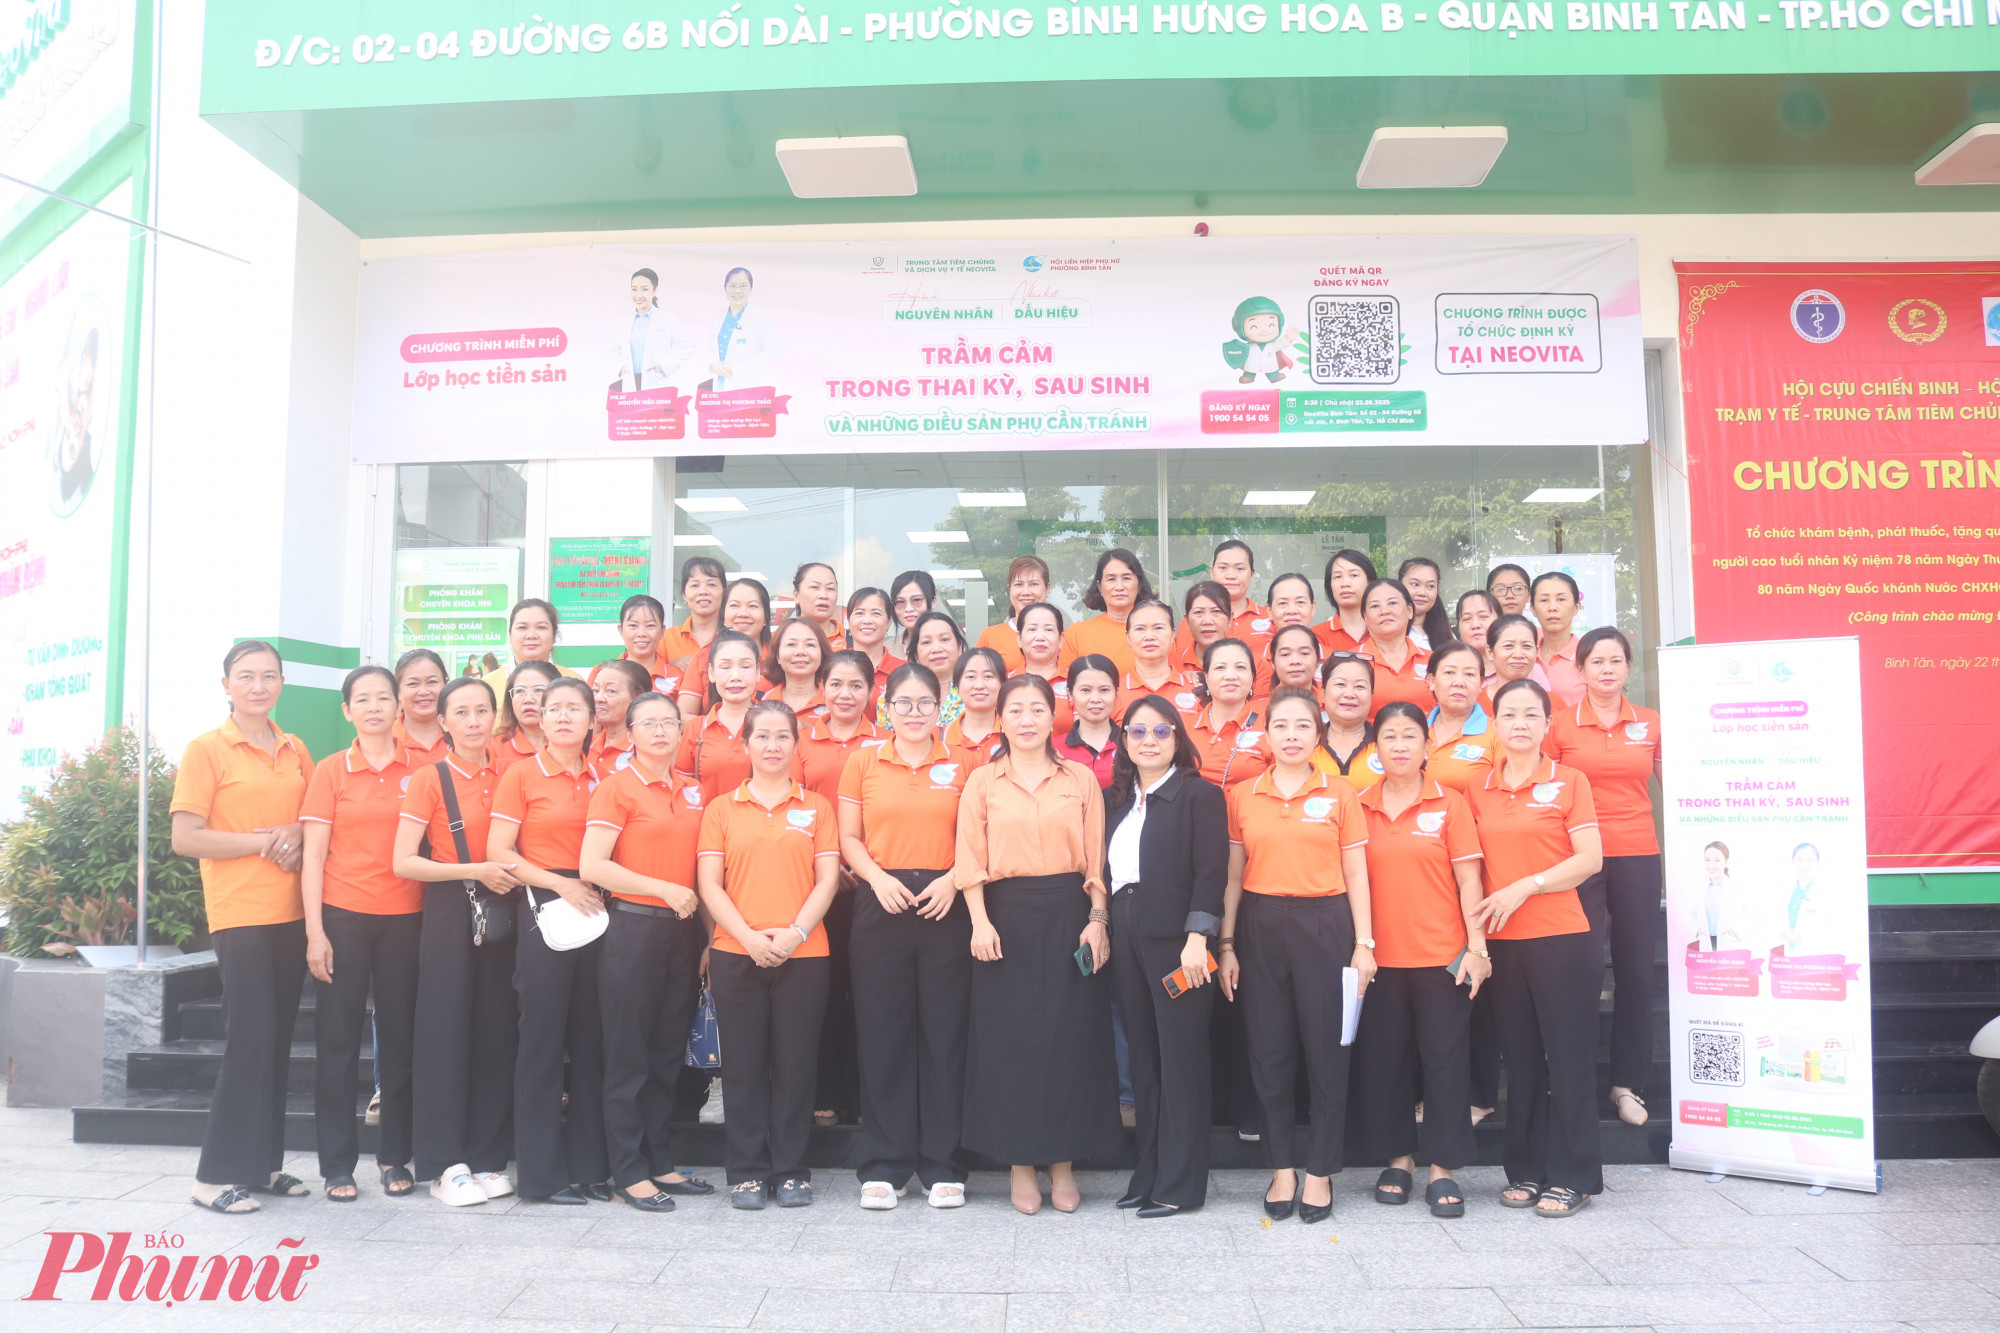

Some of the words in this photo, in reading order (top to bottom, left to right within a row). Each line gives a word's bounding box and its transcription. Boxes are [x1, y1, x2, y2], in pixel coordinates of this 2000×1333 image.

[255, 35, 341, 67] Đ/C:
[470, 13, 612, 57] ĐƯỜNG
[622, 20, 668, 50] 6B
[681, 2, 749, 49] NỐI
[763, 3, 828, 46] DÀI
[864, 0, 1033, 41] PHƯỜNG
[1153, 4, 1267, 34] HƯNG
[1381, 3, 1403, 32] B
[1320, 266, 1346, 275] QUÉT
[1350, 266, 1364, 274] MÃ
[1314, 278, 1342, 286] ĐĂNG
[1346, 278, 1358, 286] KÝ
[896, 308, 949, 319] NGUYÊN
[954, 307, 992, 318] NHÂN
[1015, 303, 1042, 318] DẤU
[1046, 306, 1077, 319] HIỆU
[1443, 307, 1503, 321] CHƯƠNG
[1508, 305, 1542, 318] TRÌNH
[1547, 308, 1586, 320] ĐƯỢC
[1458, 322, 1474, 337] TỔ
[1478, 324, 1515, 337] CHỨC
[1520, 326, 1553, 339] ĐỊNH
[1558, 324, 1574, 336] KỲ
[410, 341, 461, 354] CHƯƠNG
[464, 338, 501, 351] TRÌNH
[504, 334, 535, 350] MIỄN
[538, 335, 560, 347] PHÍ
[921, 337, 990, 364] TRẦM
[999, 339, 1051, 363] CẢM
[1448, 346, 1482, 368] TẠI
[1490, 345, 1584, 362] NEOVITA
[404, 370, 439, 391] Lớp
[446, 368, 480, 389] học
[486, 363, 525, 383] tiền
[531, 363, 566, 382] sản
[826, 379, 910, 397] TRONG
[918, 379, 974, 395] THAI
[984, 373, 1021, 398] KỲ,
[1035, 377, 1083, 394] SAU
[1091, 376, 1148, 393] SINH
[1783, 379, 1814, 399] HỘI
[1819, 381, 1856, 399] CỰU
[1861, 376, 1914, 395] CHIẾN
[1918, 381, 1960, 396] BINH
[1209, 403, 1234, 412] ĐĂNG
[1236, 402, 1245, 412] KÝ
[1248, 404, 1270, 412] NGAY
[1715, 408, 1762, 425] TRẠM
[1767, 408, 1778, 421] Y
[1782, 402, 1800, 421] TẾ
[1814, 406, 1871, 421] TRUNG
[1875, 404, 1912, 420] TÂM
[1916, 403, 1955, 420] TIÊM
[829, 416, 853, 432] VÀ
[857, 416, 918, 431] NHỮNG
[923, 411, 962, 430] ĐIỀU
[967, 412, 1001, 430] SẢN
[1007, 417, 1041, 432] PHỤ
[1047, 410, 1082, 428] CẦN
[1087, 413, 1146, 430] TRÁNH
[1734, 456, 1910, 490] CHƯƠNG
[1920, 451, 2000, 489] TRÌN
[1746, 525, 1760, 537] Tổ
[1764, 527, 1795, 537] chức
[1799, 526, 1834, 537] khám
[1838, 526, 1873, 539] bệnh,
[1877, 526, 1906, 538] phát
[1910, 524, 1949, 537] thuốc,
[1952, 525, 1982, 538] tặng
[1713, 556, 1748, 569] người
[1752, 558, 1776, 566] cao
[1780, 552, 1804, 565] tuổi
[1808, 555, 1838, 565] nhân
[1843, 554, 1858, 567] Kỷ
[1862, 554, 1892, 567] niệm
[1896, 554, 1911, 564] 78
[1915, 554, 1943, 564] năm
[1947, 553, 1980, 566] Ngày
[429, 587, 457, 597] PHÒNG
[460, 587, 483, 597] KHÁM
[1758, 584, 1772, 594] 80
[1776, 584, 1804, 594] năm
[1808, 583, 1841, 596] Ngày
[1845, 581, 1878, 593] Quốc
[1883, 582, 1921, 593] khánh
[1925, 582, 1957, 592] Nước
[1962, 582, 2000, 592] CHXH
[420, 598, 451, 608] CHUYÊN
[454, 599, 476, 608] KHOA
[478, 599, 492, 607] NHI
[1848, 611, 1888, 624] (Công
[1892, 610, 1918, 621] trình
[1922, 610, 1954, 620] chào
[1958, 610, 1994, 623] mừng
[428, 621, 456, 631] PHÒNG
[459, 621, 482, 631] KHÁM
[443, 632, 464, 641] KHOA
[1884, 657, 1909, 667] Bình
[1914, 656, 1936, 668] Tân,
[1940, 657, 1971, 670] ngày
[1974, 656, 1988, 666] 22
[1677, 798, 1720, 807] TRONG
[1724, 798, 1754, 806] THAI
[1786, 797, 1812, 806] SAU
[1817, 797, 1848, 806] SINH
